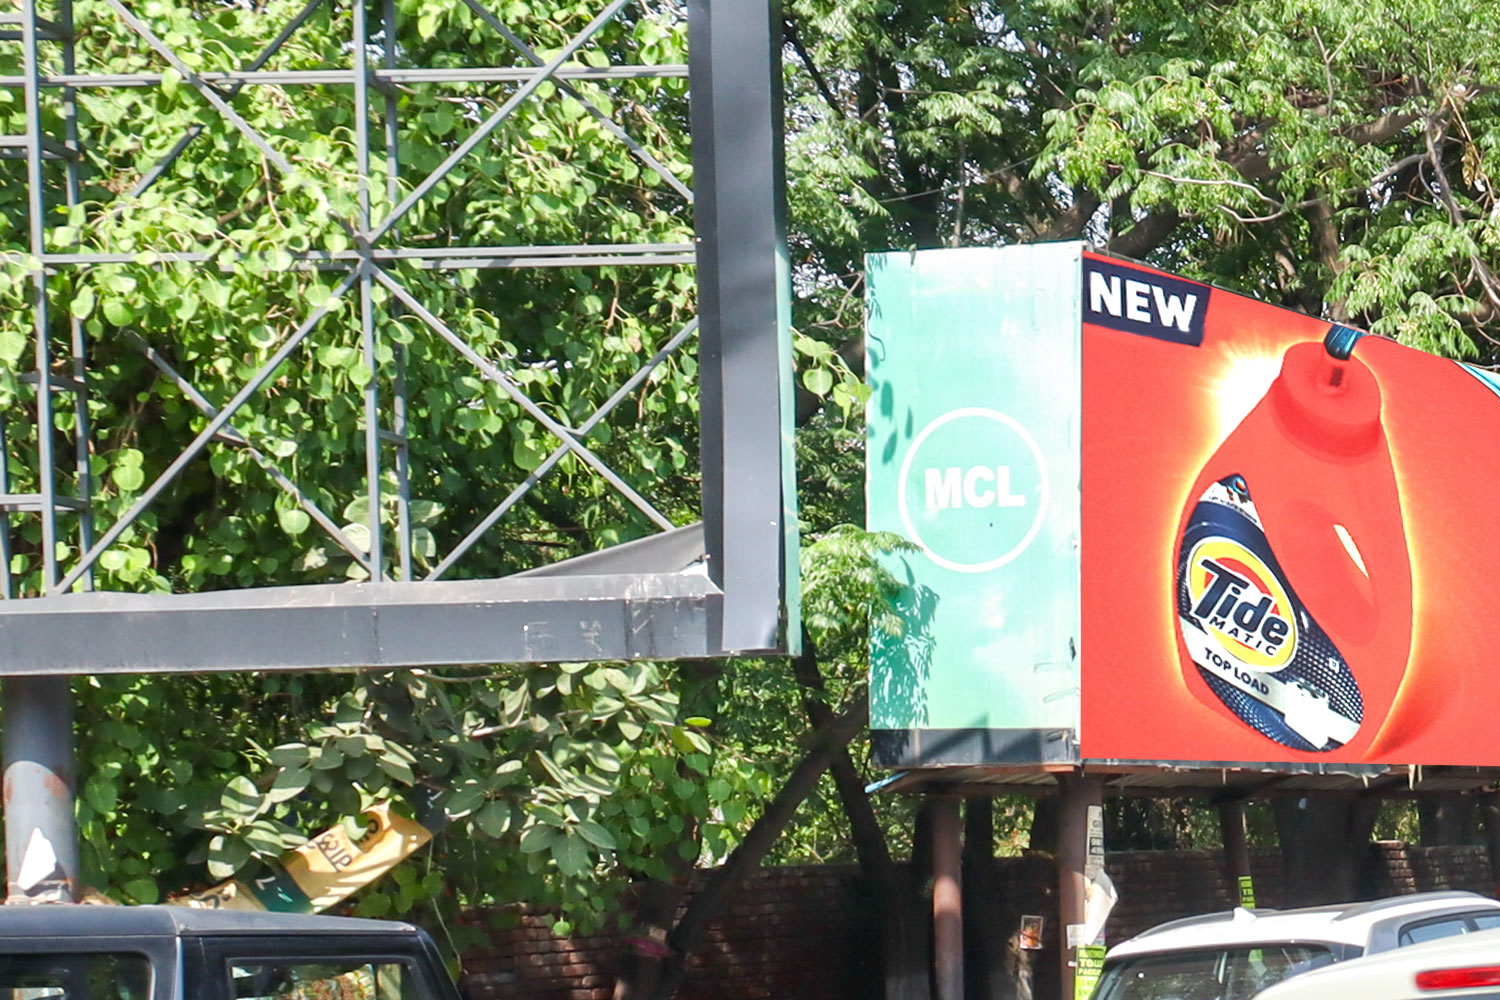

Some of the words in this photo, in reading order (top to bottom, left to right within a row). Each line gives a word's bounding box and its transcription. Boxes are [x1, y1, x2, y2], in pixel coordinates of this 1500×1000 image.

[1089, 271, 1197, 333] NEW
[924, 465, 1025, 509] MCL
[1194, 559, 1290, 647] Tide
[1209, 616, 1277, 656] MATIC
[1204, 647, 1231, 671] TOP
[1233, 666, 1270, 696] LOAD
